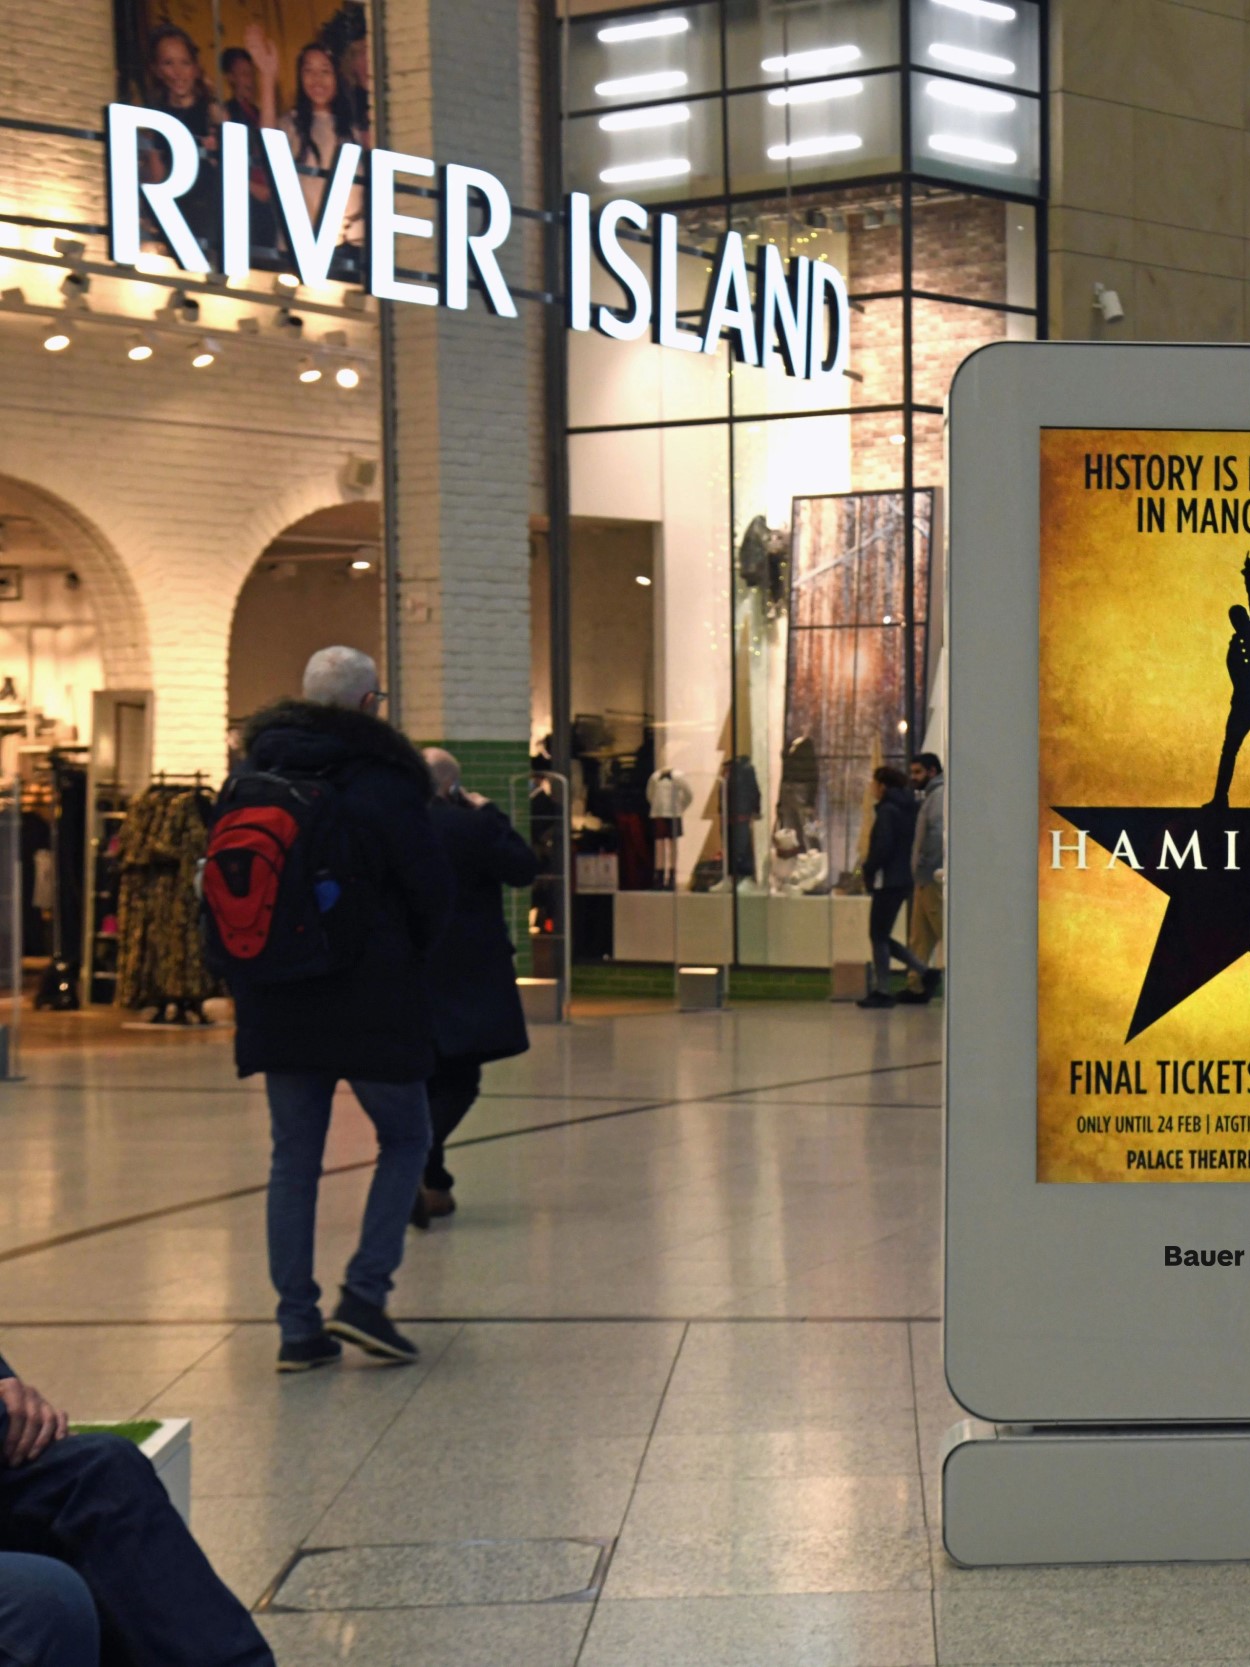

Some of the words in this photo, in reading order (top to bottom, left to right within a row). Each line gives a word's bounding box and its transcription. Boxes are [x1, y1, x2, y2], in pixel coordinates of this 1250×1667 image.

[107, 103, 518, 319] RIVER
[567, 191, 851, 380] ISLAND
[1084, 453, 1203, 491] HISTORY
[1214, 455, 1238, 492] IS
[1137, 497, 1165, 533] IN
[1070, 1060, 1147, 1095] FINAL
[1077, 1115, 1111, 1134] ONLY
[1115, 1115, 1154, 1134] UNTIL
[1157, 1115, 1174, 1133] 24
[1178, 1115, 1202, 1133] FEB
[1127, 1150, 1183, 1169] PALACE
[1164, 1245, 1245, 1266] Bauer
